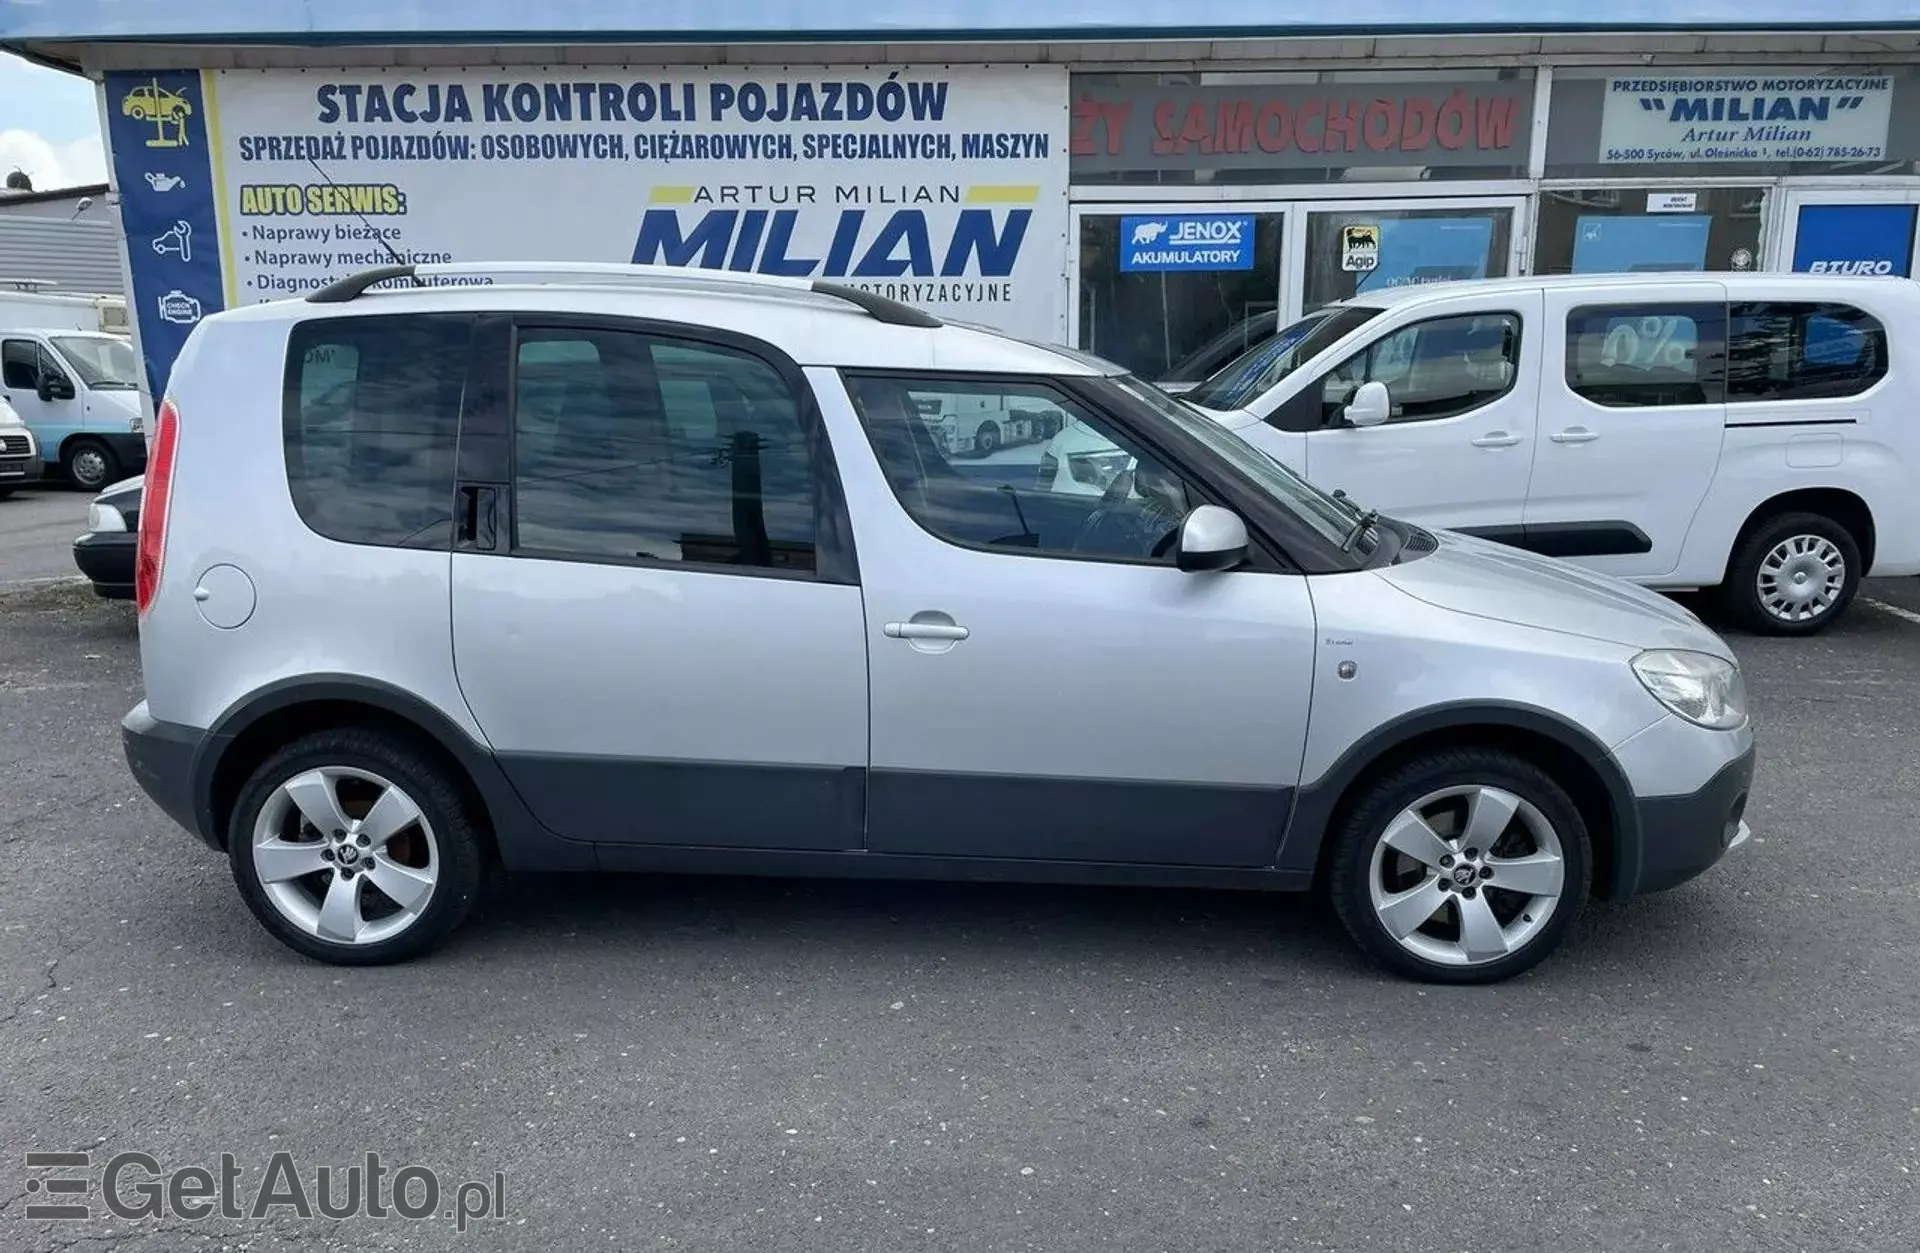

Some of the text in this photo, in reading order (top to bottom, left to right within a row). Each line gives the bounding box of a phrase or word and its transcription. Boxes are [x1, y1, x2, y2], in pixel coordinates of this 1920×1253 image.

[1613, 78, 1888, 94] PRZEDSIĘBIORSTWO MOTORYZACYJNE
[317, 71, 949, 123] STACJA KONTROLI POJAZDÓW
[1151, 88, 1518, 156] SAMOCHODÓW
[1681, 124, 1812, 142] Artur Milian
[239, 130, 1049, 163] SPRZEDAŻ POJAZDÓW: OSOBOWYCH, CIĘŻAROWYCH, SPECJALNYCH, MASZYN
[1607, 149, 1644, 160] 56-500
[239, 183, 408, 216] AUTO SERWIS:
[693, 185, 961, 203] ARTUR MILIAN
[252, 223, 401, 244] Naprawy bieżące
[1168, 220, 1242, 244] JENOX
[630, 208, 1033, 278] MILIAN
[254, 249, 452, 268] Naprawy mechaniczne
[1131, 249, 1241, 264] AKUMULATORY
[1345, 254, 1375, 269] Agip
[1808, 260, 1893, 275] BIURO
[843, 283, 1012, 302] TORYZACYJNE
